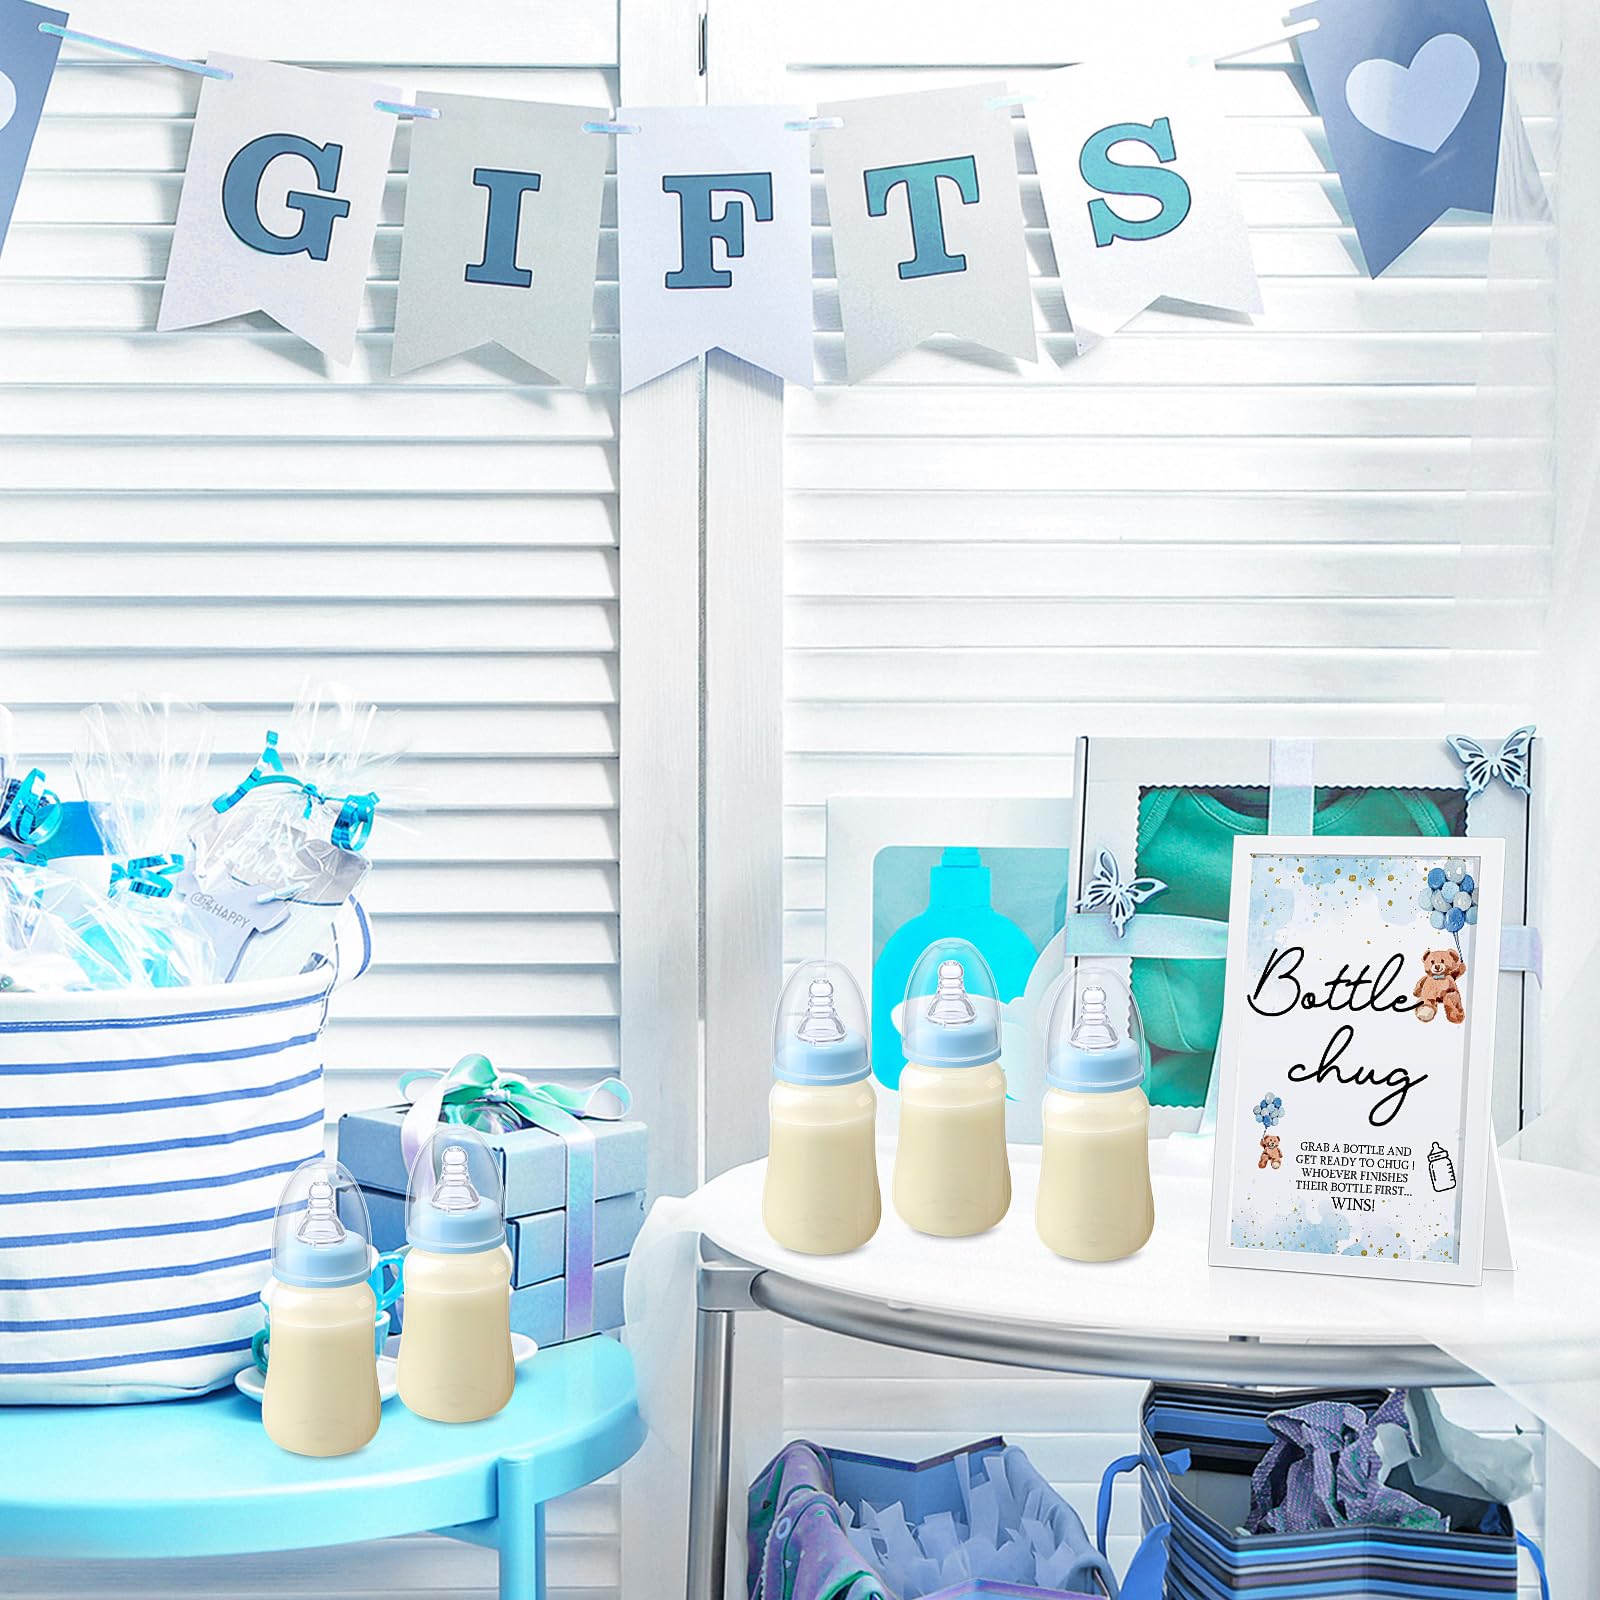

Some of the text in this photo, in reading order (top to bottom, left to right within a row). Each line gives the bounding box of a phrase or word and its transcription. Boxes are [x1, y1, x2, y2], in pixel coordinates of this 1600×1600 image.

[220, 116, 1193, 290] GIFTS
[211, 904, 250, 928] HAPPY
[1247, 946, 1425, 1017] Bottle
[1287, 1024, 1429, 1127] chug
[1300, 1141, 1412, 1157] GRAB A BOTTLE AND
[1295, 1154, 1318, 1165] GET
[1319, 1156, 1357, 1166] READY
[1358, 1157, 1375, 1168] TO
[1301, 1168, 1409, 1183] WHOEVER FINISHES
[1295, 1180, 1412, 1197] THEIR BOTTLE FIRST...
[1331, 1196, 1376, 1212] WINS!
